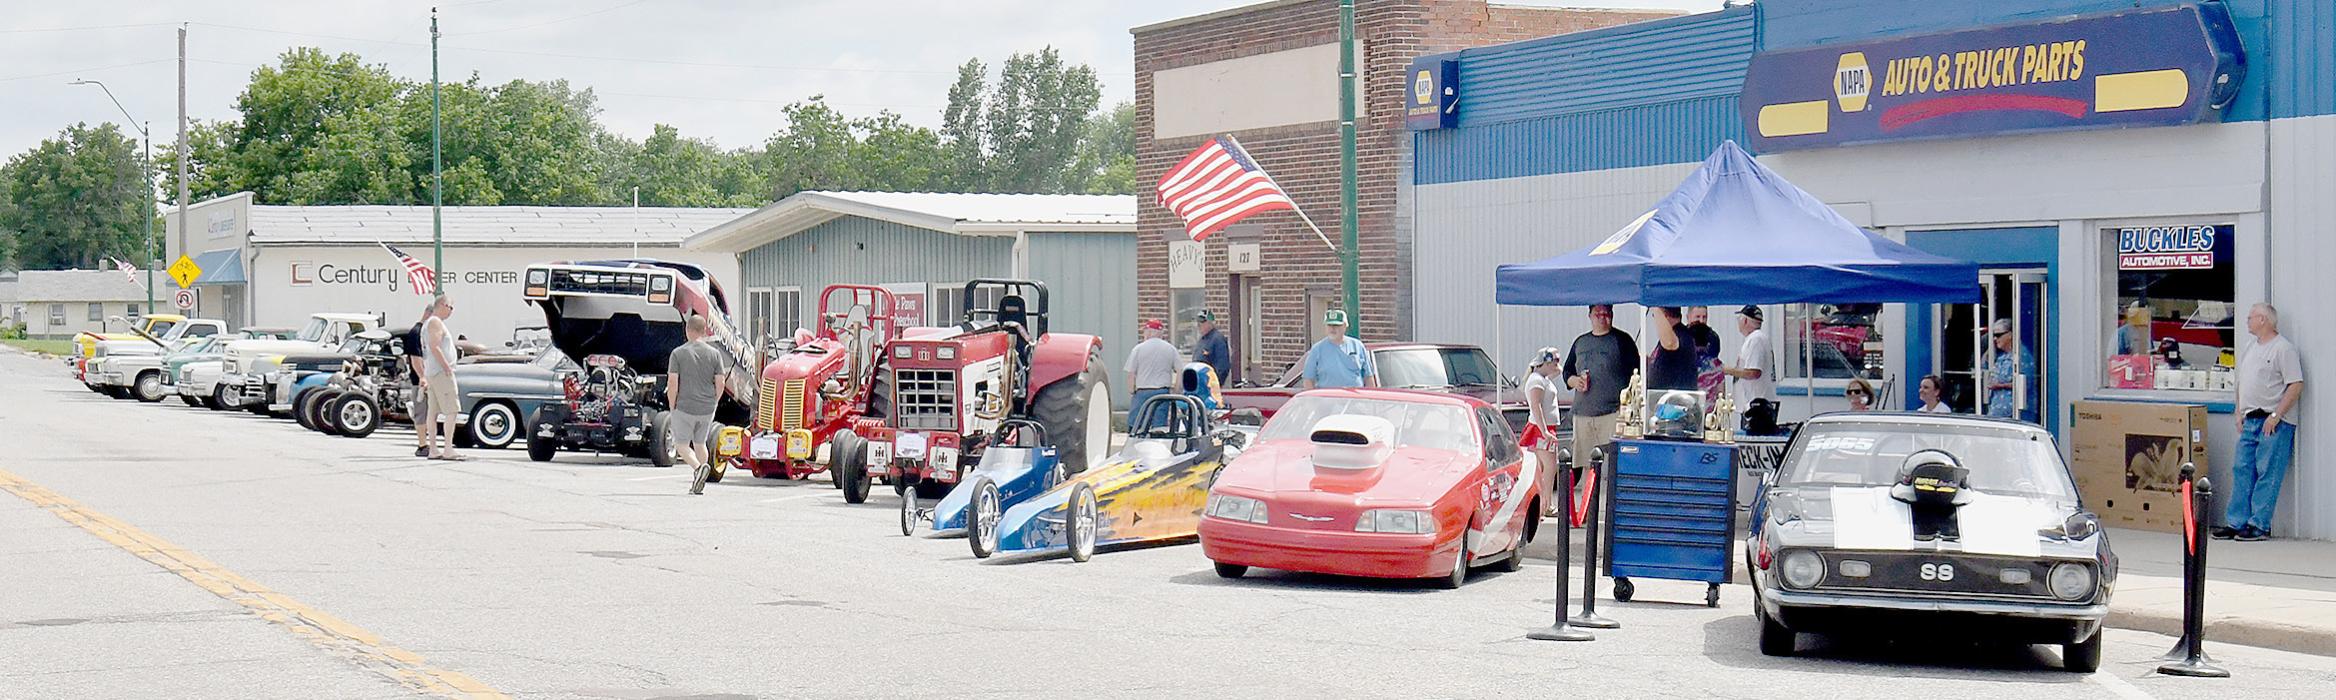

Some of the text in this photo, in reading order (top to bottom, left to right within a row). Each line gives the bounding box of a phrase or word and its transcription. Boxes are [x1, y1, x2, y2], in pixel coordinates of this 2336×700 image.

[1882, 39, 2086, 97] AUTO & TRUCK PARTS
[1840, 69, 1865, 95] NAPA
[2120, 226, 2214, 251] BUCKLES
[2122, 255, 2211, 267] AUTOMOTIVE, INC.
[319, 264, 398, 292] Century
[465, 271, 517, 284] CENTER
[1920, 562, 1954, 581] SS
